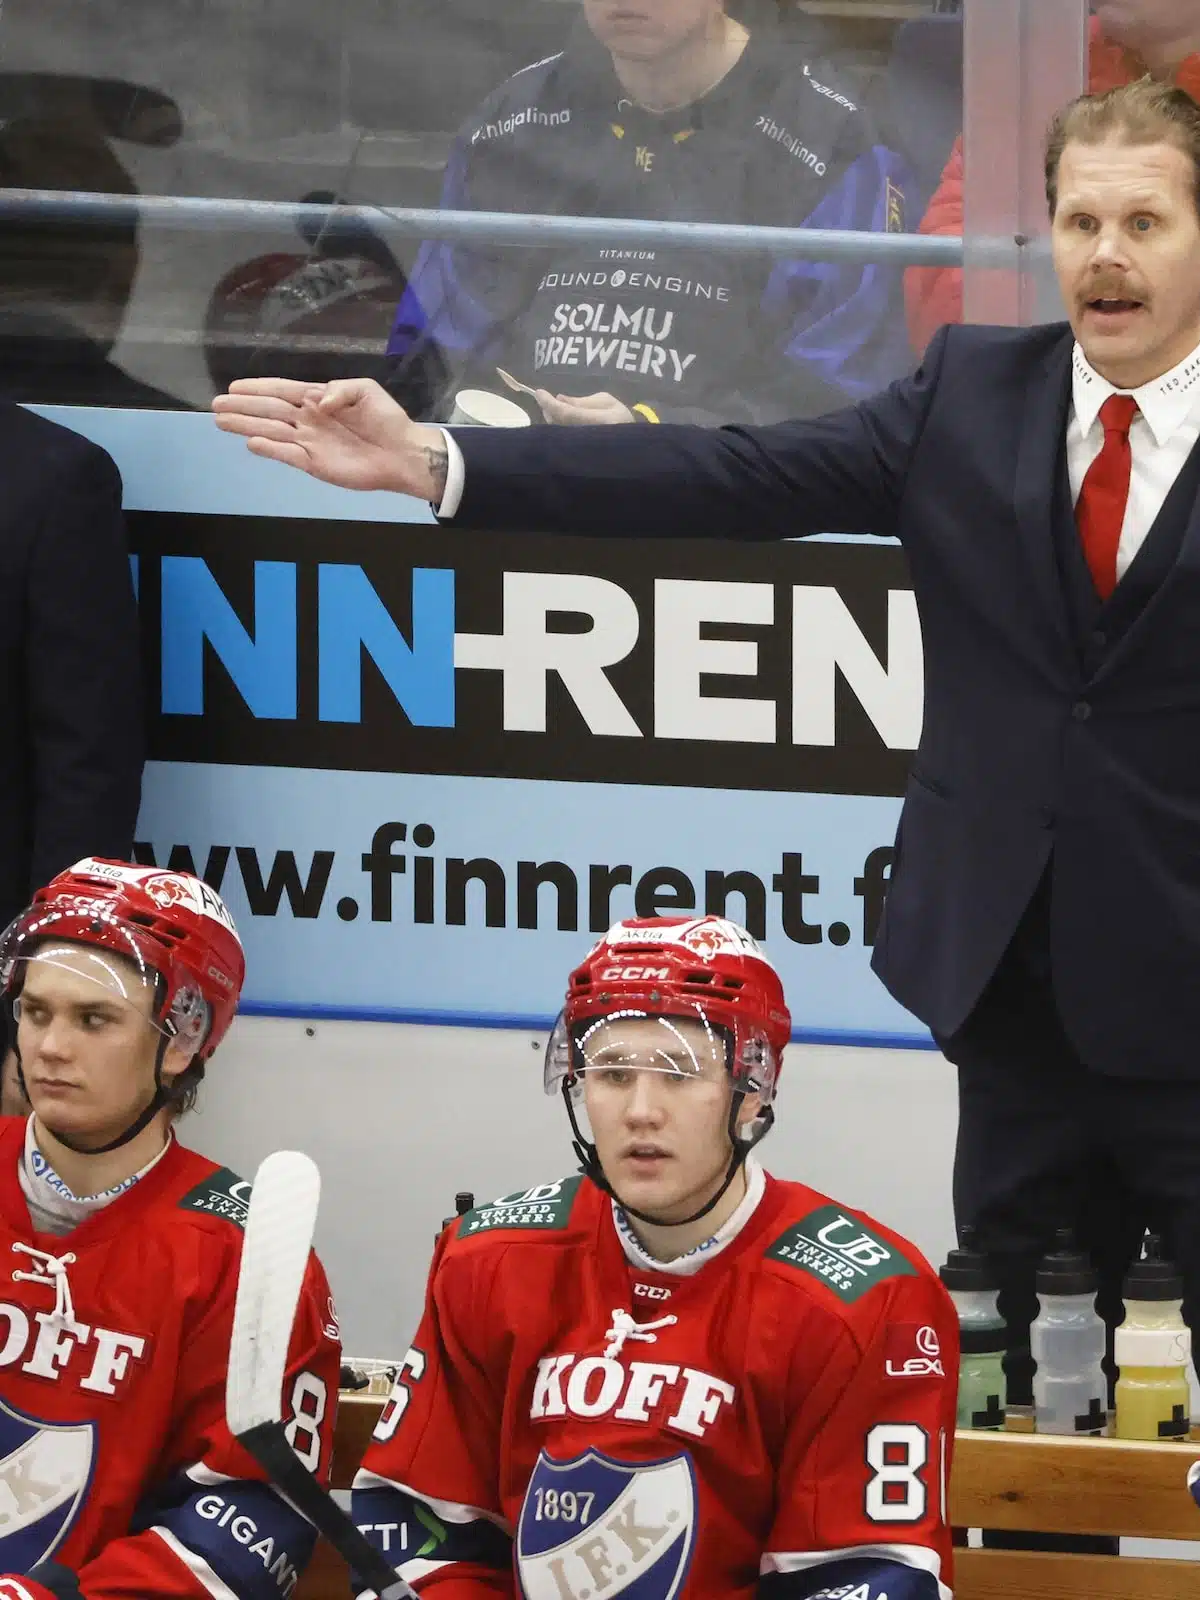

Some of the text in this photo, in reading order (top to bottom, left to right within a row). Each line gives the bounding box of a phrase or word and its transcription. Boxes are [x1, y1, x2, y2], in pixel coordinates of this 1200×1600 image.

[600, 249, 656, 261] TITANIUM
[628, 272, 731, 302] ENGINE
[549, 302, 675, 341] SOLMU
[534, 335, 697, 382] BREWERY
[1159, 376, 1181, 396] TED
[128, 553, 925, 750] NN-REN
[84, 862, 124, 879] Aktia
[621, 929, 663, 940] Aktia
[602, 966, 670, 981] CCM
[468, 1213, 556, 1232] BANKERS
[480, 1204, 551, 1221] UNITED
[817, 1205, 892, 1267] UB
[777, 1245, 852, 1291] BANKERS
[795, 1240, 855, 1279] UNITED
[529, 1353, 737, 1438] KOFF
[534, 1487, 596, 1526] 1897
